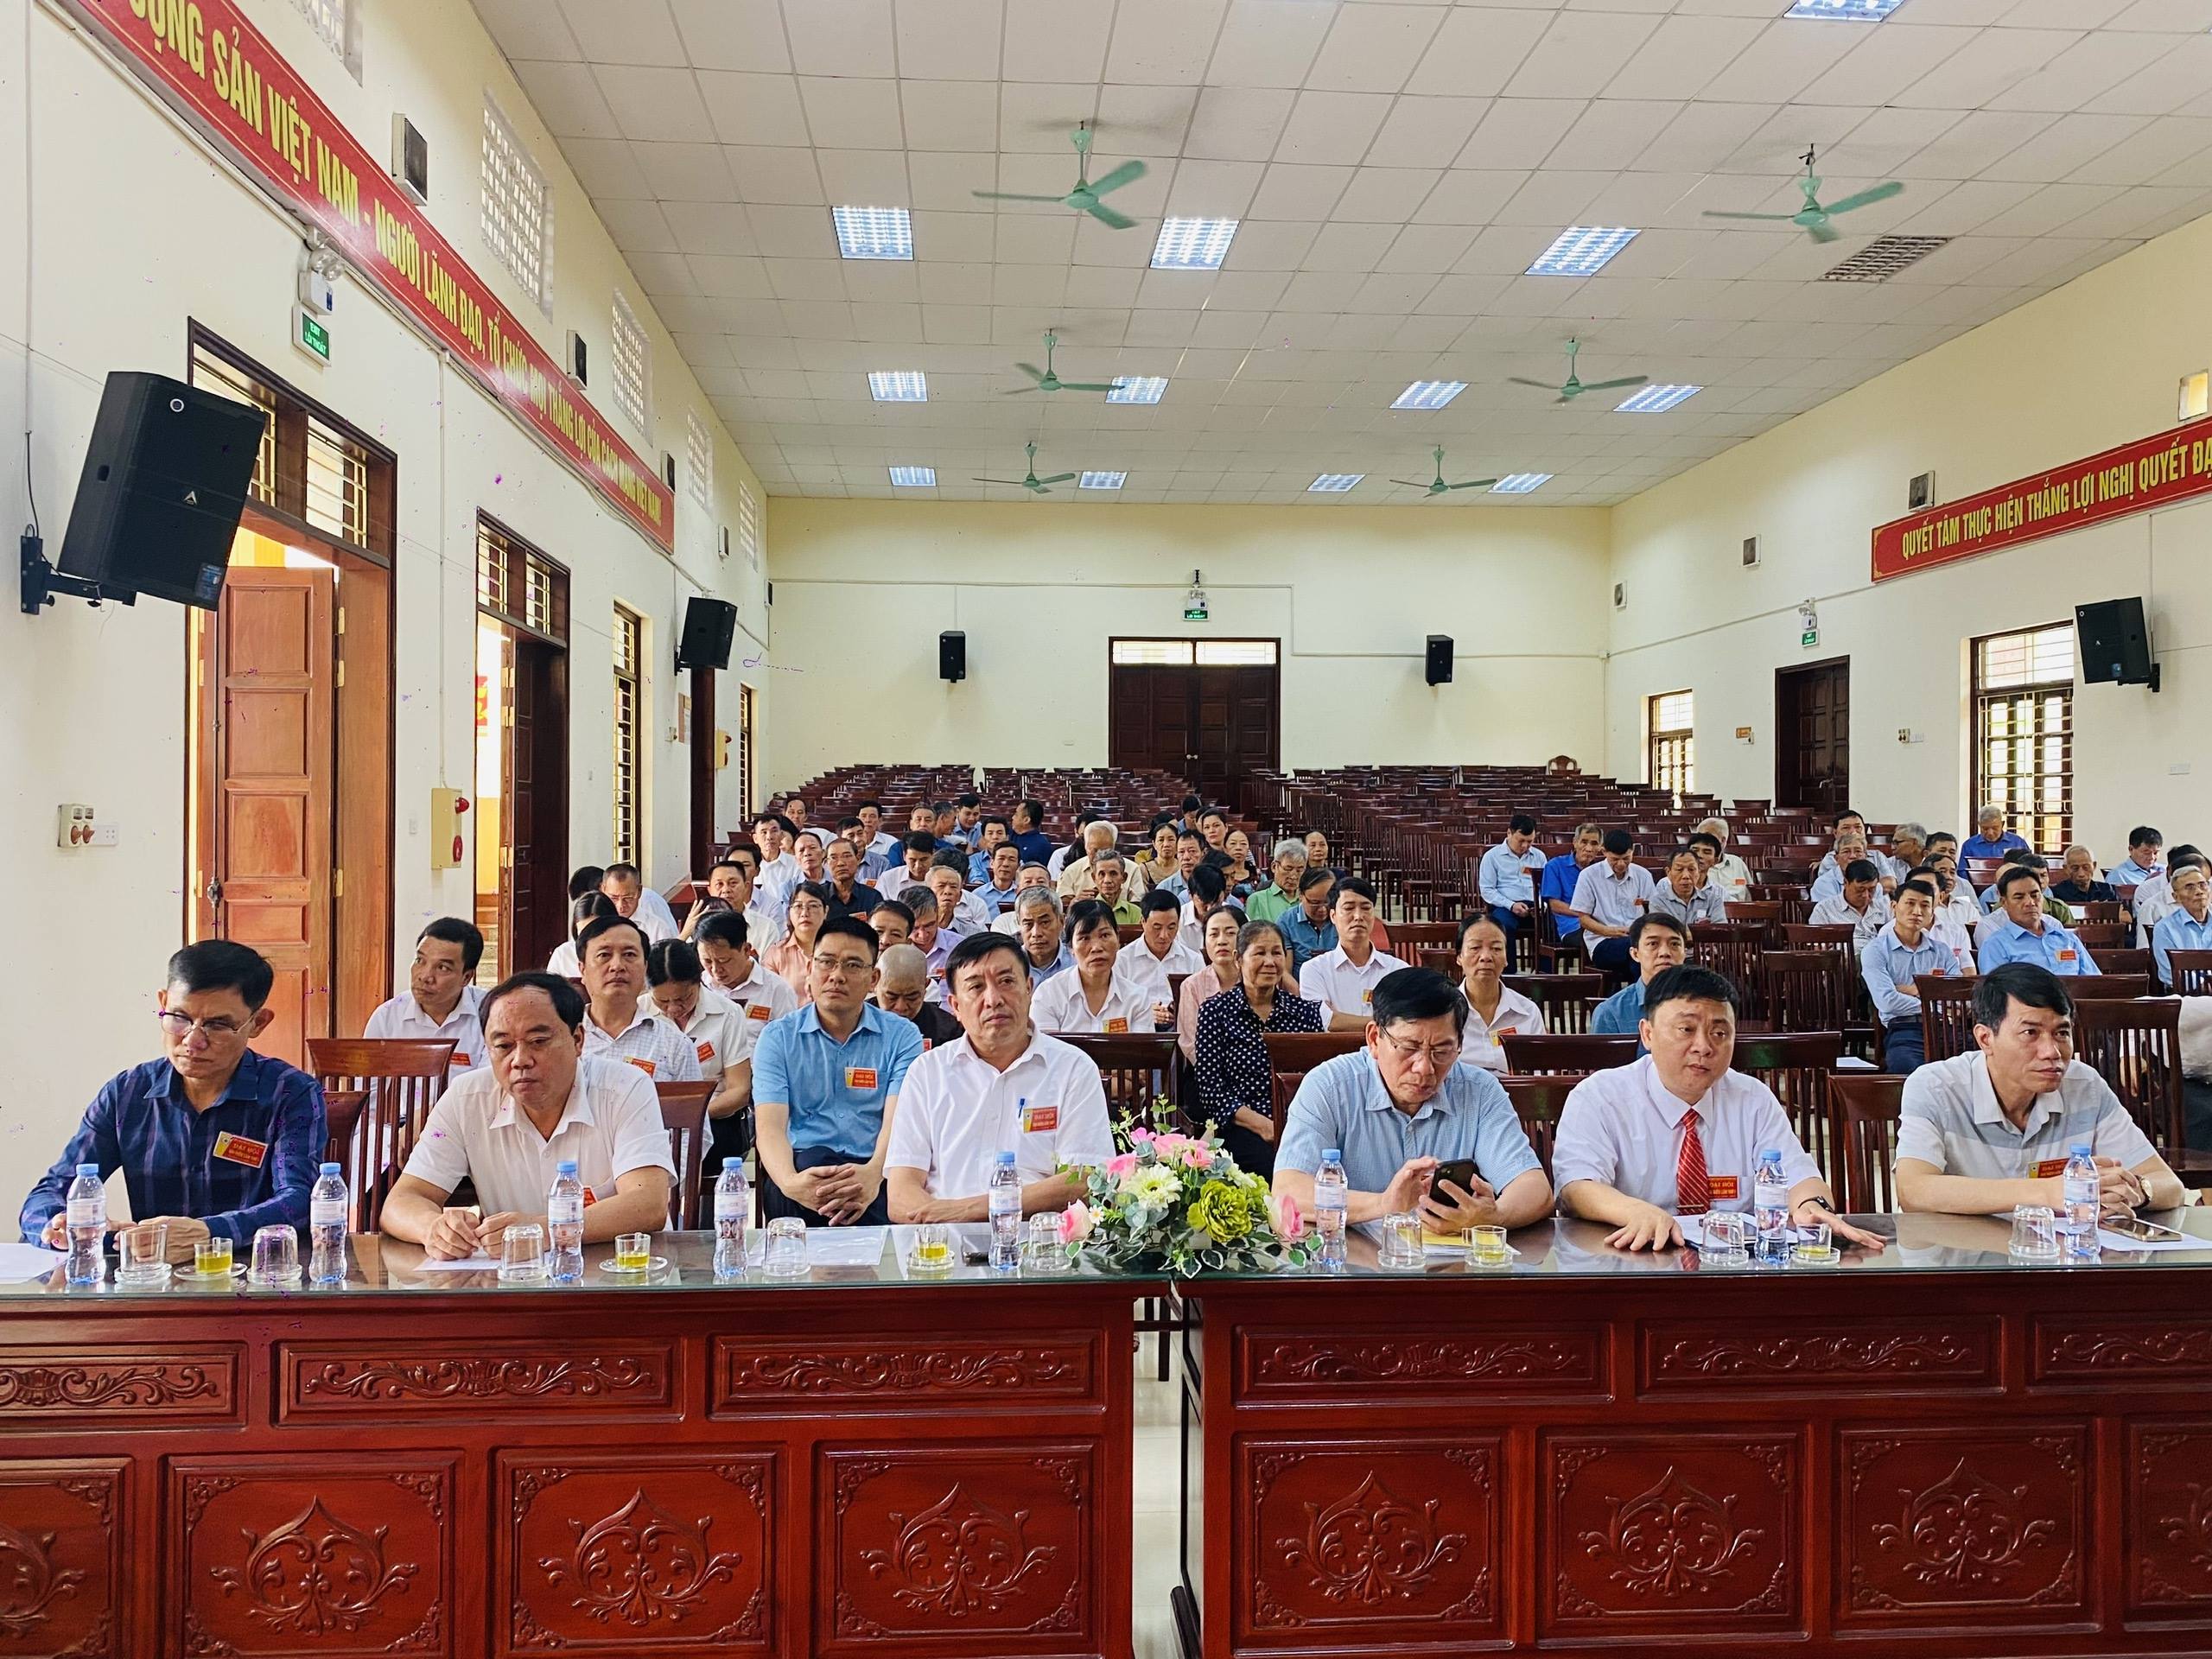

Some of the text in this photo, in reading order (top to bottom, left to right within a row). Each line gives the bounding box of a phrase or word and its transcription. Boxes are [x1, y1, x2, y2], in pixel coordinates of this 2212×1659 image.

[213, 26, 263, 136] SẢN
[267, 84, 311, 185] VIỆT
[316, 136, 359, 228] NAM
[374, 198, 421, 291] NGƯỜI
[423, 250, 458, 327] LÃNH
[460, 288, 486, 359] ĐẠO,
[487, 310, 500, 368] TỔ
[530, 363, 546, 421] MỌI
[548, 380, 574, 442] THẮNG
[575, 410, 587, 459] LỢI
[1903, 517, 1935, 560] QUYẾT
[1936, 514, 1960, 548] TÂM
[1962, 505, 1992, 543] THỰC
[1995, 494, 2024, 535] HIỆN
[2027, 477, 2069, 523] THẮNG
[2074, 472, 2094, 513] LỢI
[2099, 461, 2134, 500] NGHỊ
[2139, 435, 2189, 493] QUYẾT
